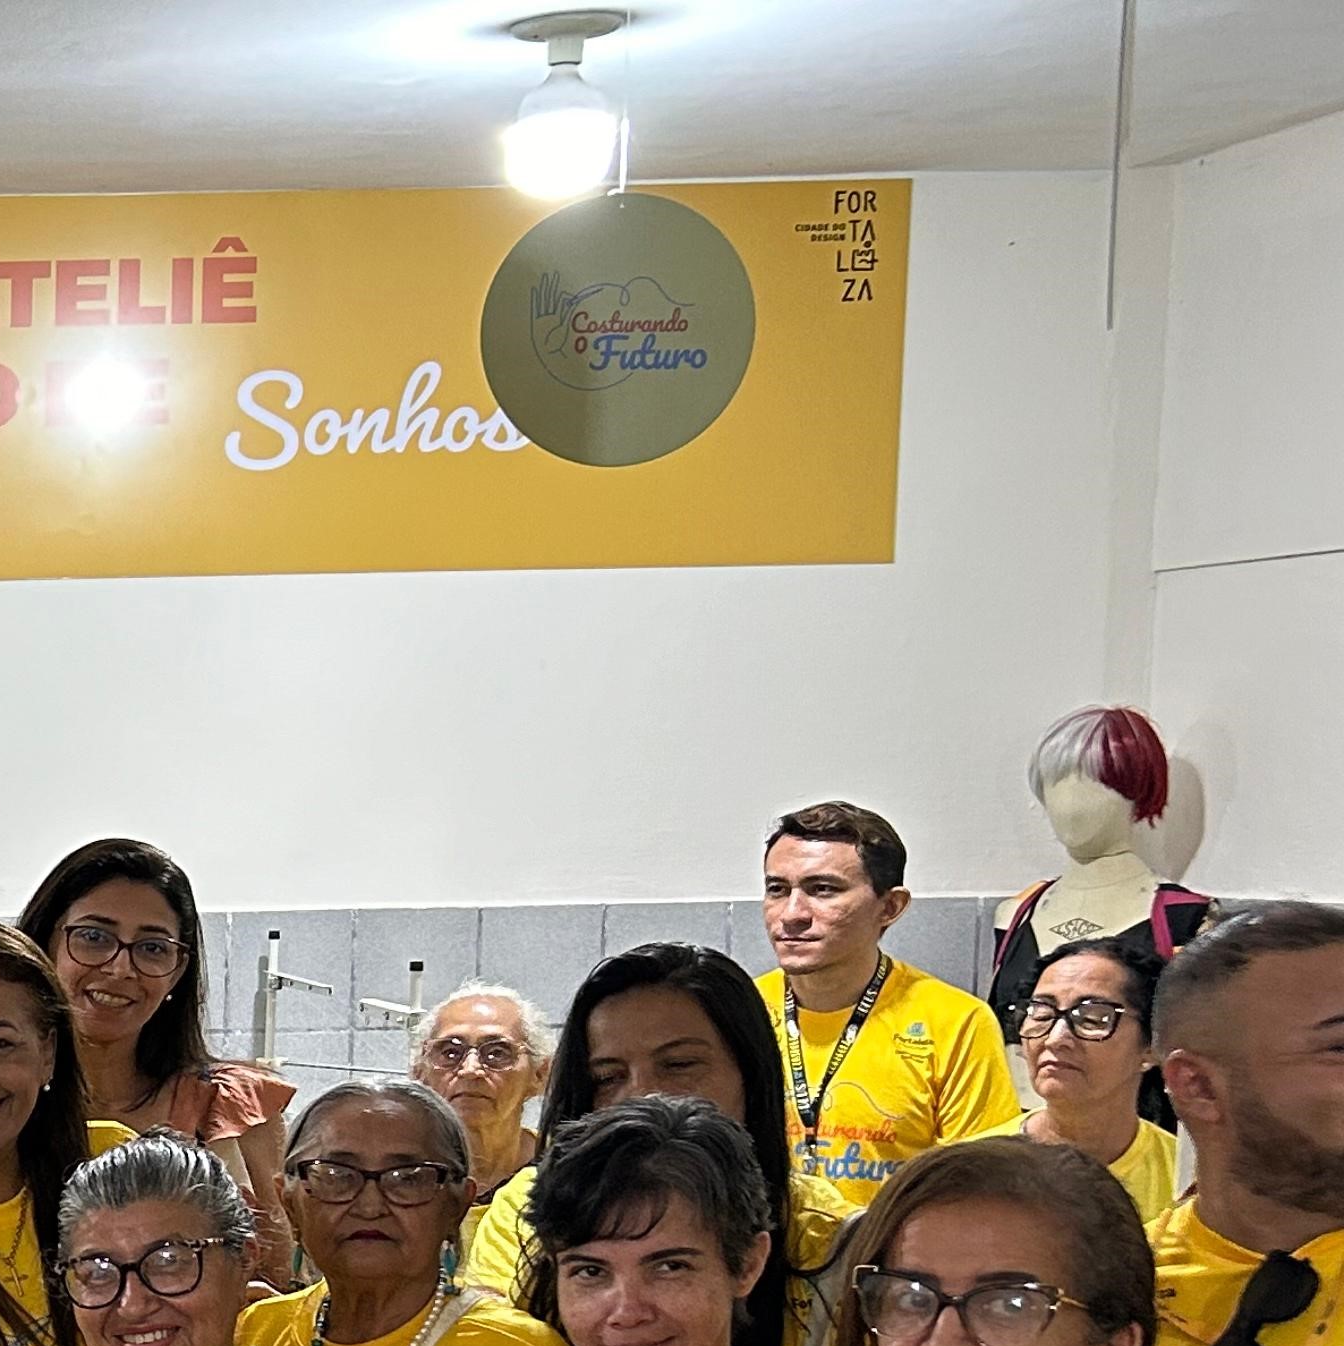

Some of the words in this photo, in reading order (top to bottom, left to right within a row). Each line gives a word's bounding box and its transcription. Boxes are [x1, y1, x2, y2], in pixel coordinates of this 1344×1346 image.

[834, 190, 877, 214] FOR
[795, 223, 829, 232] CIDADE
[811, 234, 846, 242] DESIGN
[571, 307, 689, 334] Costurando
[589, 332, 708, 372] Futuro
[224, 360, 531, 472] Sonhos
